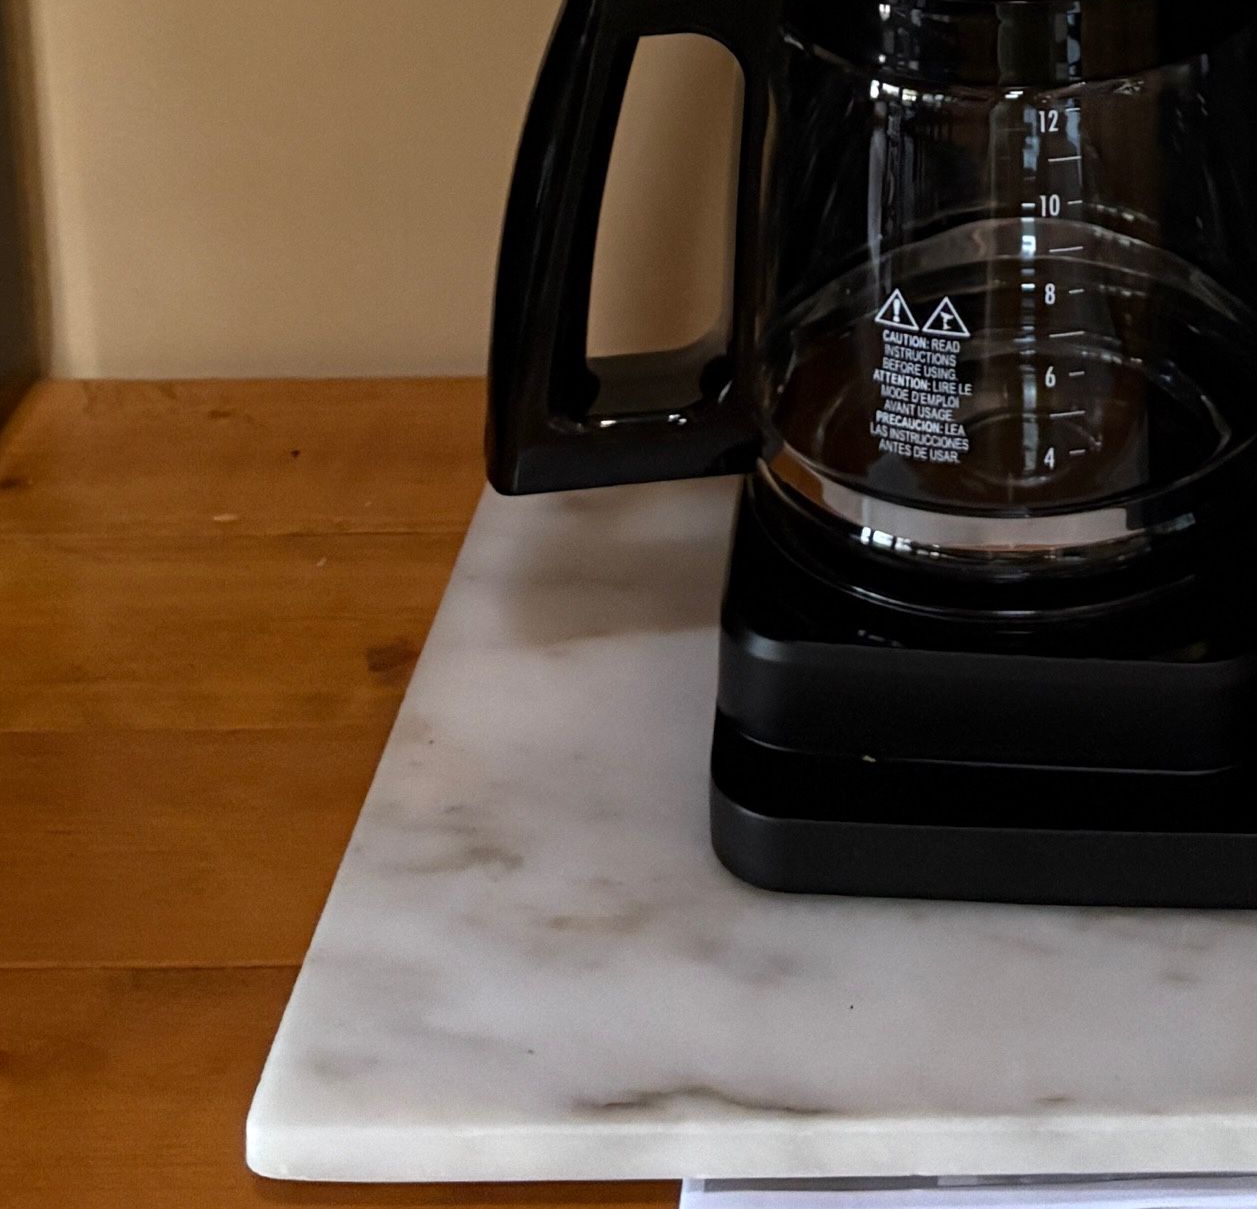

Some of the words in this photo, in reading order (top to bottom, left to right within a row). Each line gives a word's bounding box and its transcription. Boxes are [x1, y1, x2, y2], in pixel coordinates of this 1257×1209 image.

[1039, 110, 1059, 133] 12
[1040, 195, 1060, 217] 10
[1044, 283, 1056, 305] 8
[883, 329, 930, 349] CAUTION:
[931, 338, 960, 353] READ
[884, 344, 957, 367] INSTRUCTIONS
[882, 357, 922, 376] BEFORE
[1044, 366, 1056, 387] 6
[873, 369, 931, 391] ATTENTION:
[932, 380, 957, 395] LIRE
[959, 384, 973, 396] LE
[881, 384, 909, 401] MODE
[884, 399, 915, 415] AVANT
[870, 421, 888, 437] LAS
[889, 428, 969, 451] INSTRUCCIONES
[944, 423, 967, 436] LEA
[879, 438, 912, 456] ANTES
[913, 446, 928, 459] DE
[1043, 448, 1055, 469] 4
